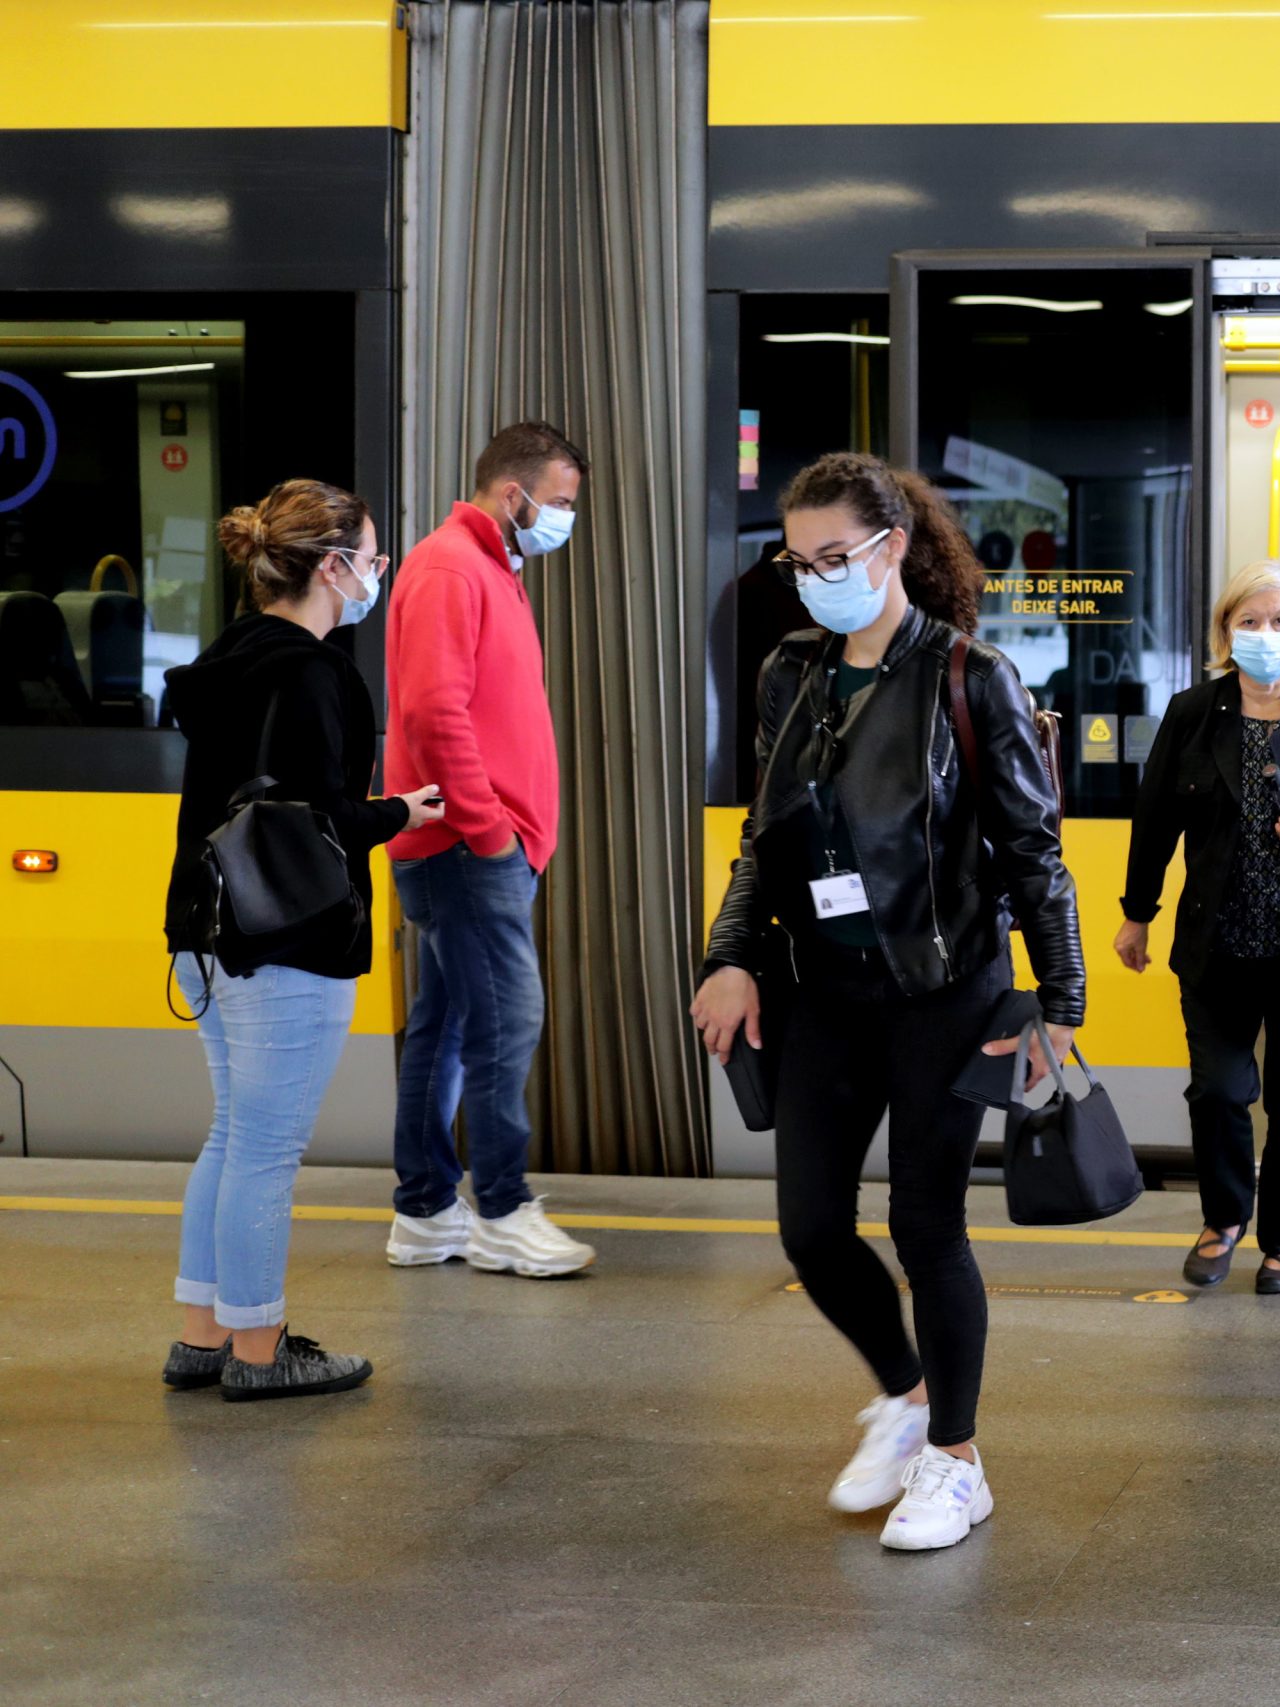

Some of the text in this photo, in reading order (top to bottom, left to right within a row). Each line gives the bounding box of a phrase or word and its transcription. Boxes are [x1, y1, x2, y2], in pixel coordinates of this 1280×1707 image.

[983, 578, 1124, 594] ANTES DE ENTRAR
[1012, 599, 1101, 614] DEIXE SAIR.
